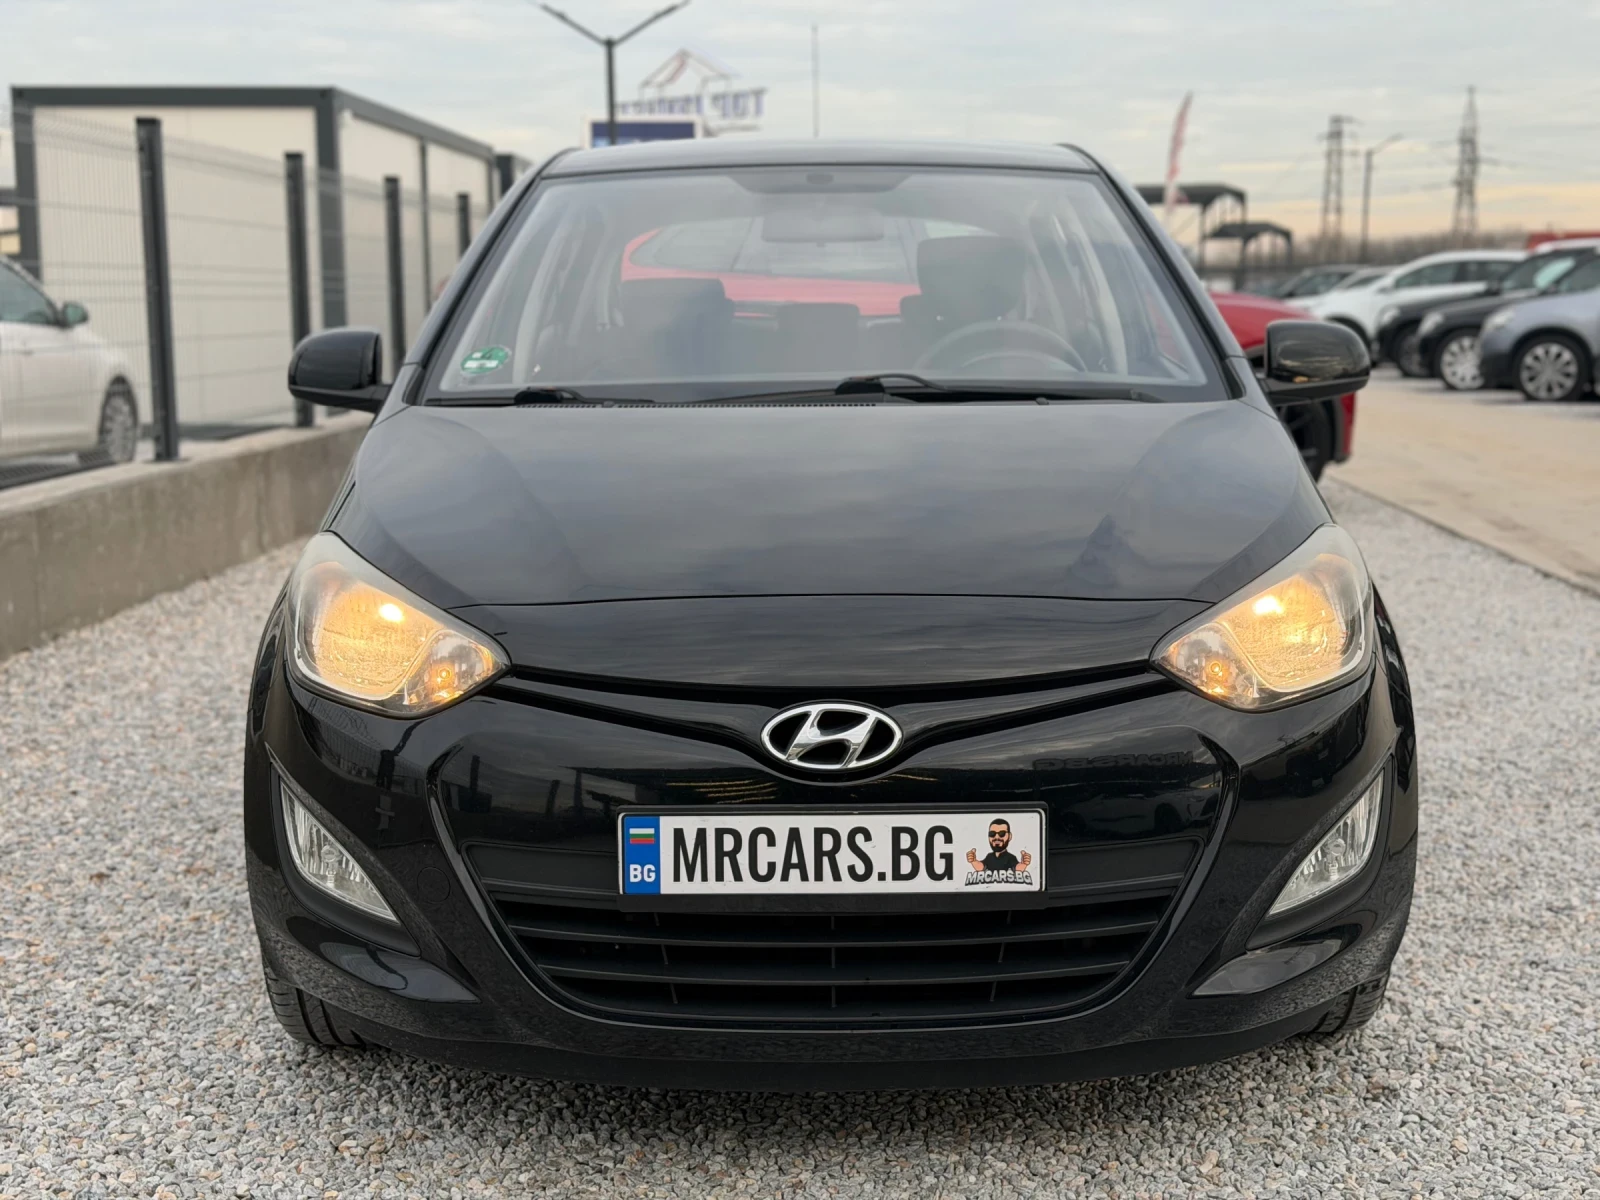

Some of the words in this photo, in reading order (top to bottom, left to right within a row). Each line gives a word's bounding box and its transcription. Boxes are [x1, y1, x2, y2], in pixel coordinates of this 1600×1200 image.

[672, 825, 954, 883] MRCARS.BG
[629, 865, 656, 883] BG
[966, 870, 1033, 886] MRCARS.BG
